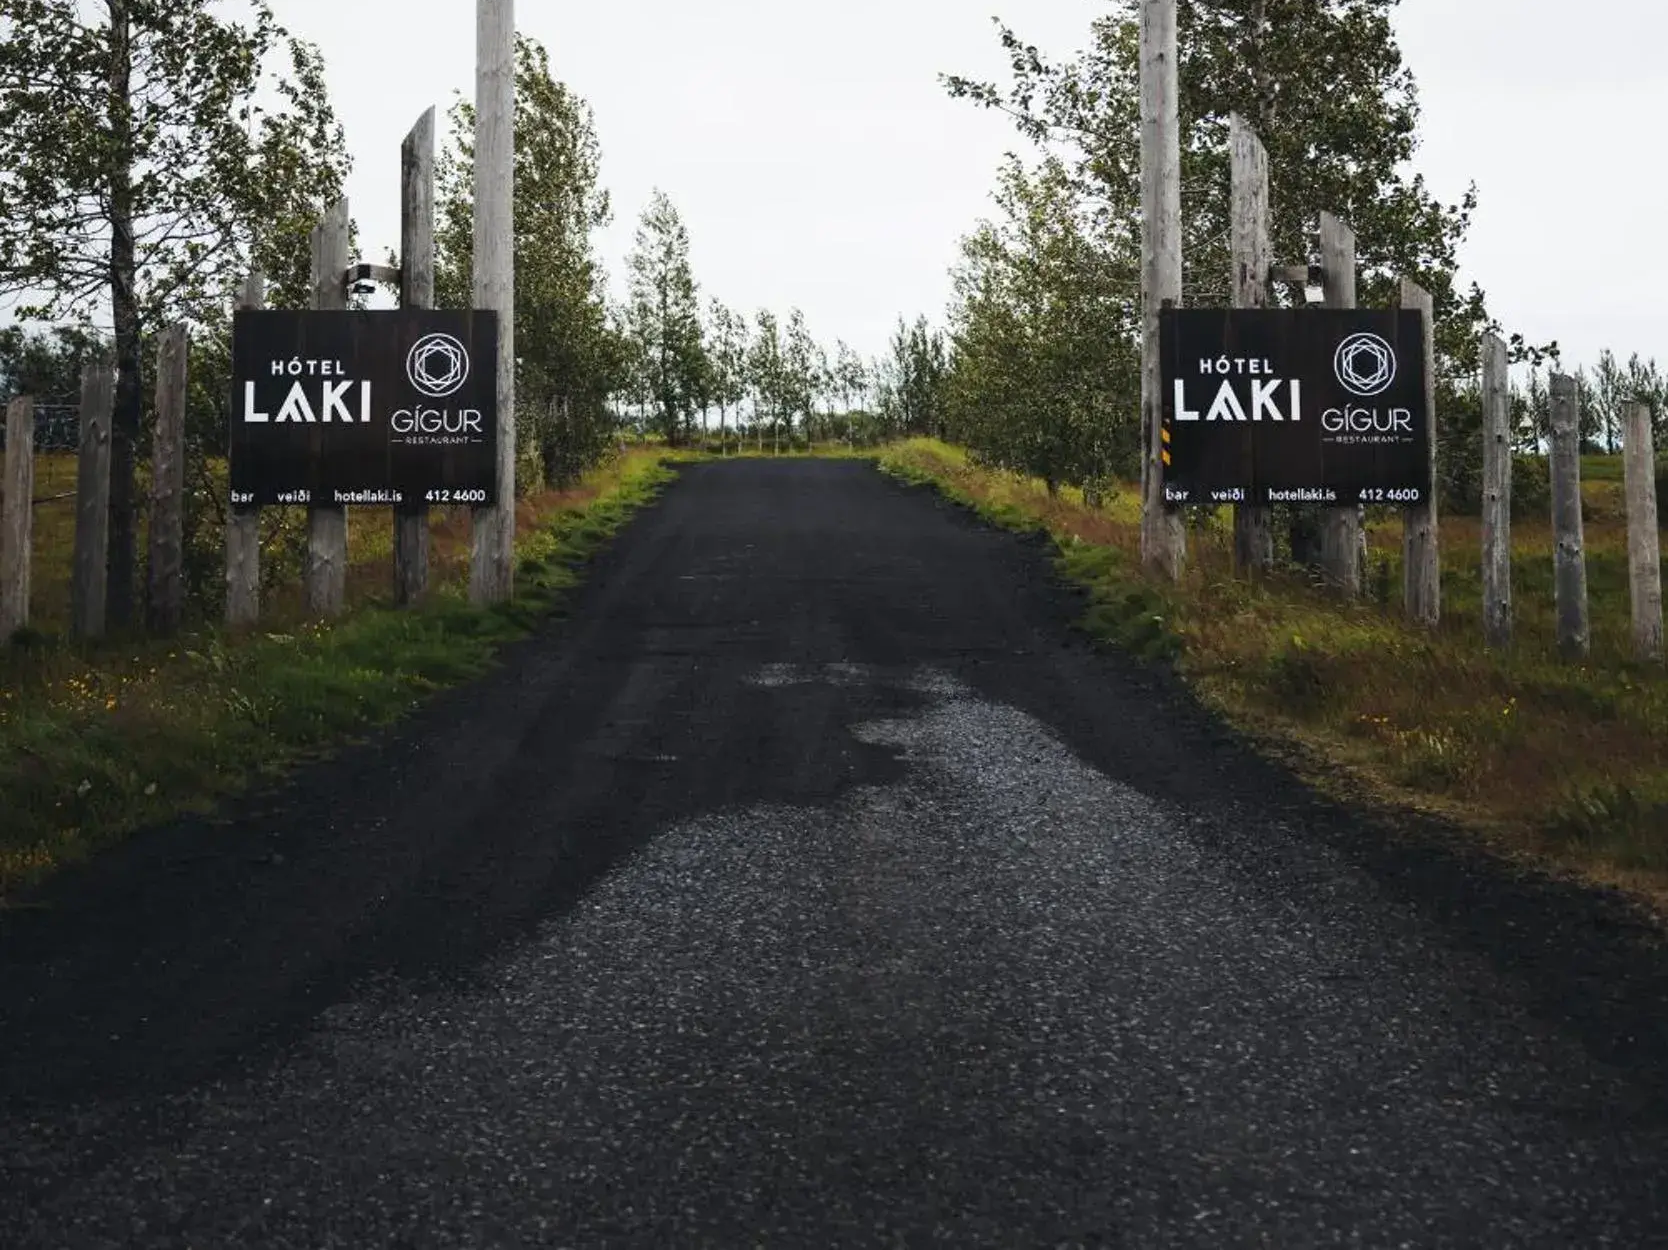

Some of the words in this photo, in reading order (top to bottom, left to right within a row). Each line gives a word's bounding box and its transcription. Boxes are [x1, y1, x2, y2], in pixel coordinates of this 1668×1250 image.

[271, 356, 345, 375] HÓTEL
[1200, 355, 1273, 374] HÓTEL
[244, 380, 371, 422] LAKI
[1174, 379, 1301, 421] LAKI
[391, 405, 482, 433] GÍGUR
[1321, 404, 1413, 431] GÍGUR
[405, 437, 469, 445] RESTAURANT
[1335, 435, 1401, 444] RESTAURANT
[231, 490, 254, 502] bar
[277, 490, 310, 502] veiði
[334, 490, 402, 502] hotellaki.is
[426, 490, 450, 501] 412
[453, 490, 485, 501] 4600
[1166, 488, 1189, 500] bar
[1211, 488, 1244, 500] veiði
[1269, 488, 1336, 501] hotellaki.is
[1359, 489, 1384, 500] 412
[1387, 489, 1419, 500] 4600
